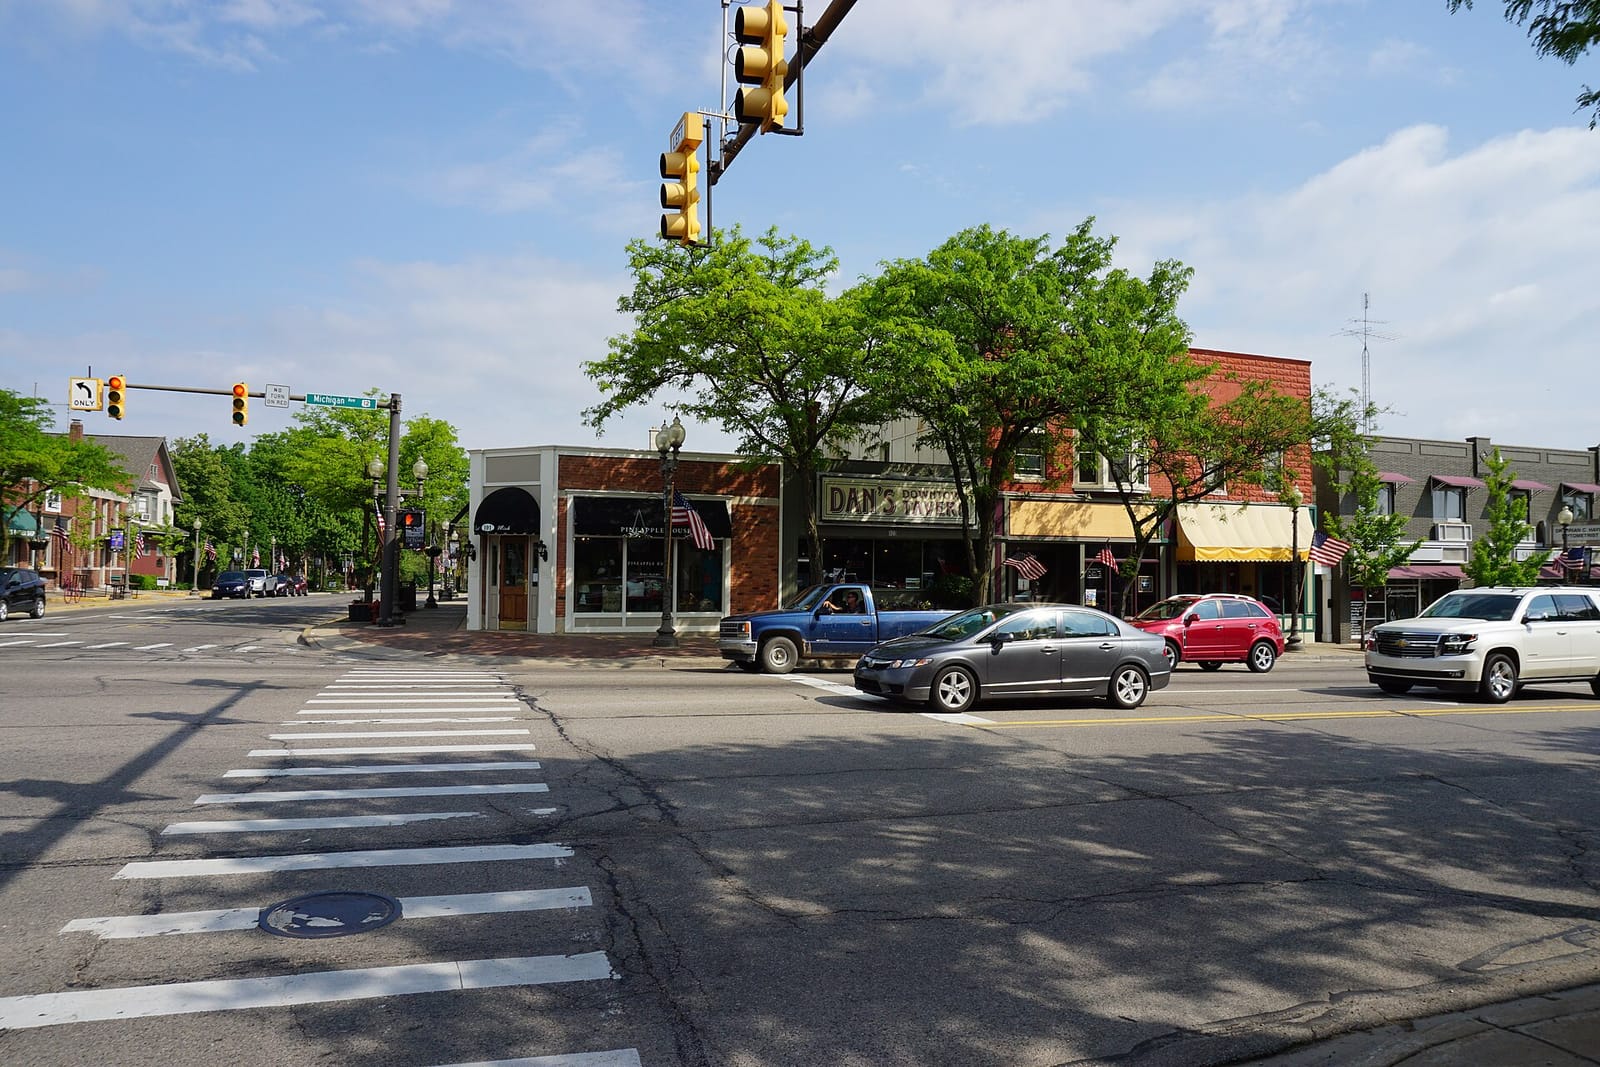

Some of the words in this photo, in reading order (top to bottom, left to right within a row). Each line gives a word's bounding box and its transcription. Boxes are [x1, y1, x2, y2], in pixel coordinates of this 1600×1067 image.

[313, 394, 345, 406] Michigan
[830, 485, 897, 515] DAN'S
[902, 489, 960, 501] DOWNTOW
[902, 500, 962, 517] TAVER
[620, 526, 665, 534] PINEAPPLE
